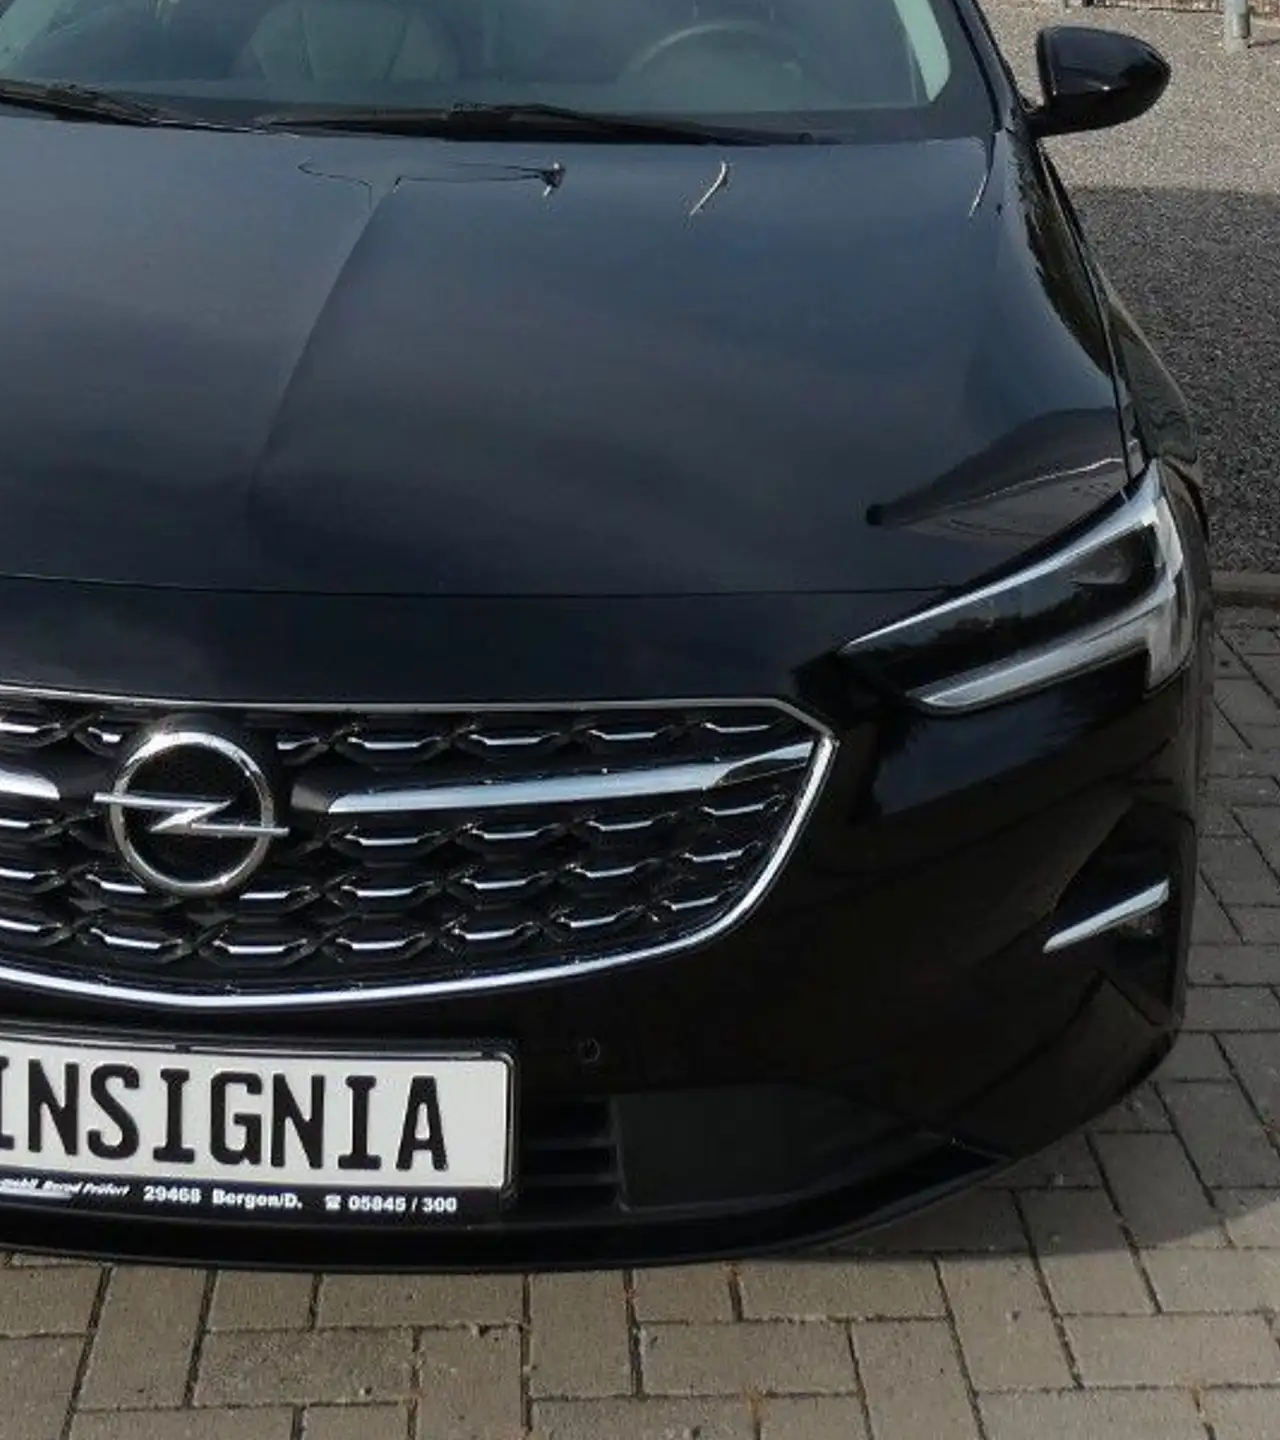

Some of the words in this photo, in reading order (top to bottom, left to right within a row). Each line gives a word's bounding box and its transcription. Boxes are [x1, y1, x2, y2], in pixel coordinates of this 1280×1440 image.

[143, 1185, 202, 1204] 29468
[348, 1194, 407, 1213] 05845
[422, 1196, 458, 1213] 300
